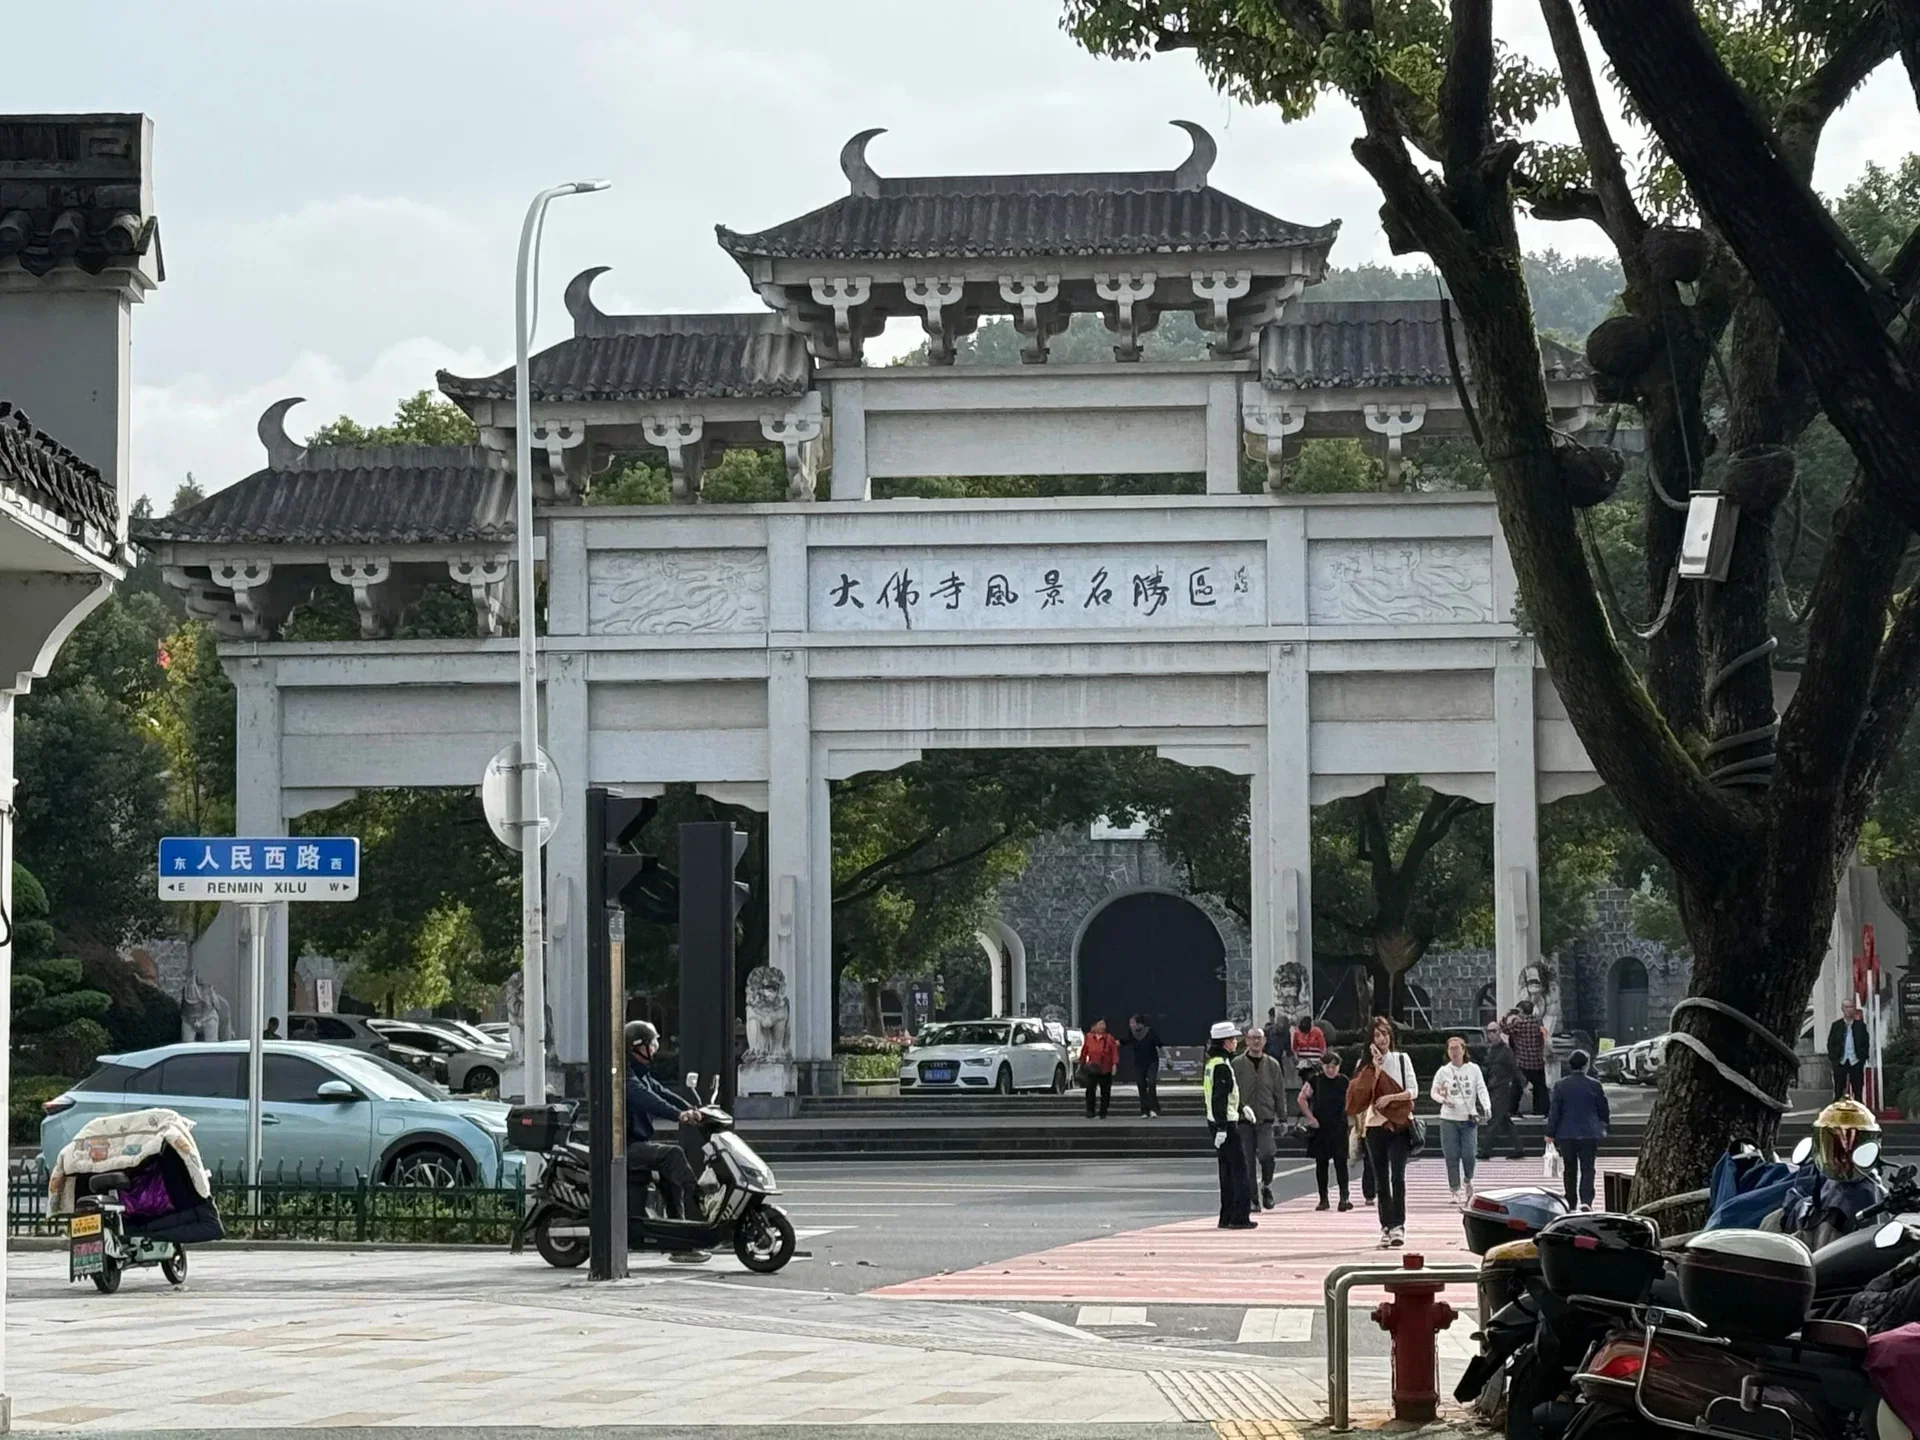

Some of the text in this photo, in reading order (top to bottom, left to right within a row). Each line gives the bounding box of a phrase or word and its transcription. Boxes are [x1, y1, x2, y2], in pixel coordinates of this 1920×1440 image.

[173, 844, 343, 871] 东 人民西路 西
[178, 882, 339, 893] E RENMIN XILU W
